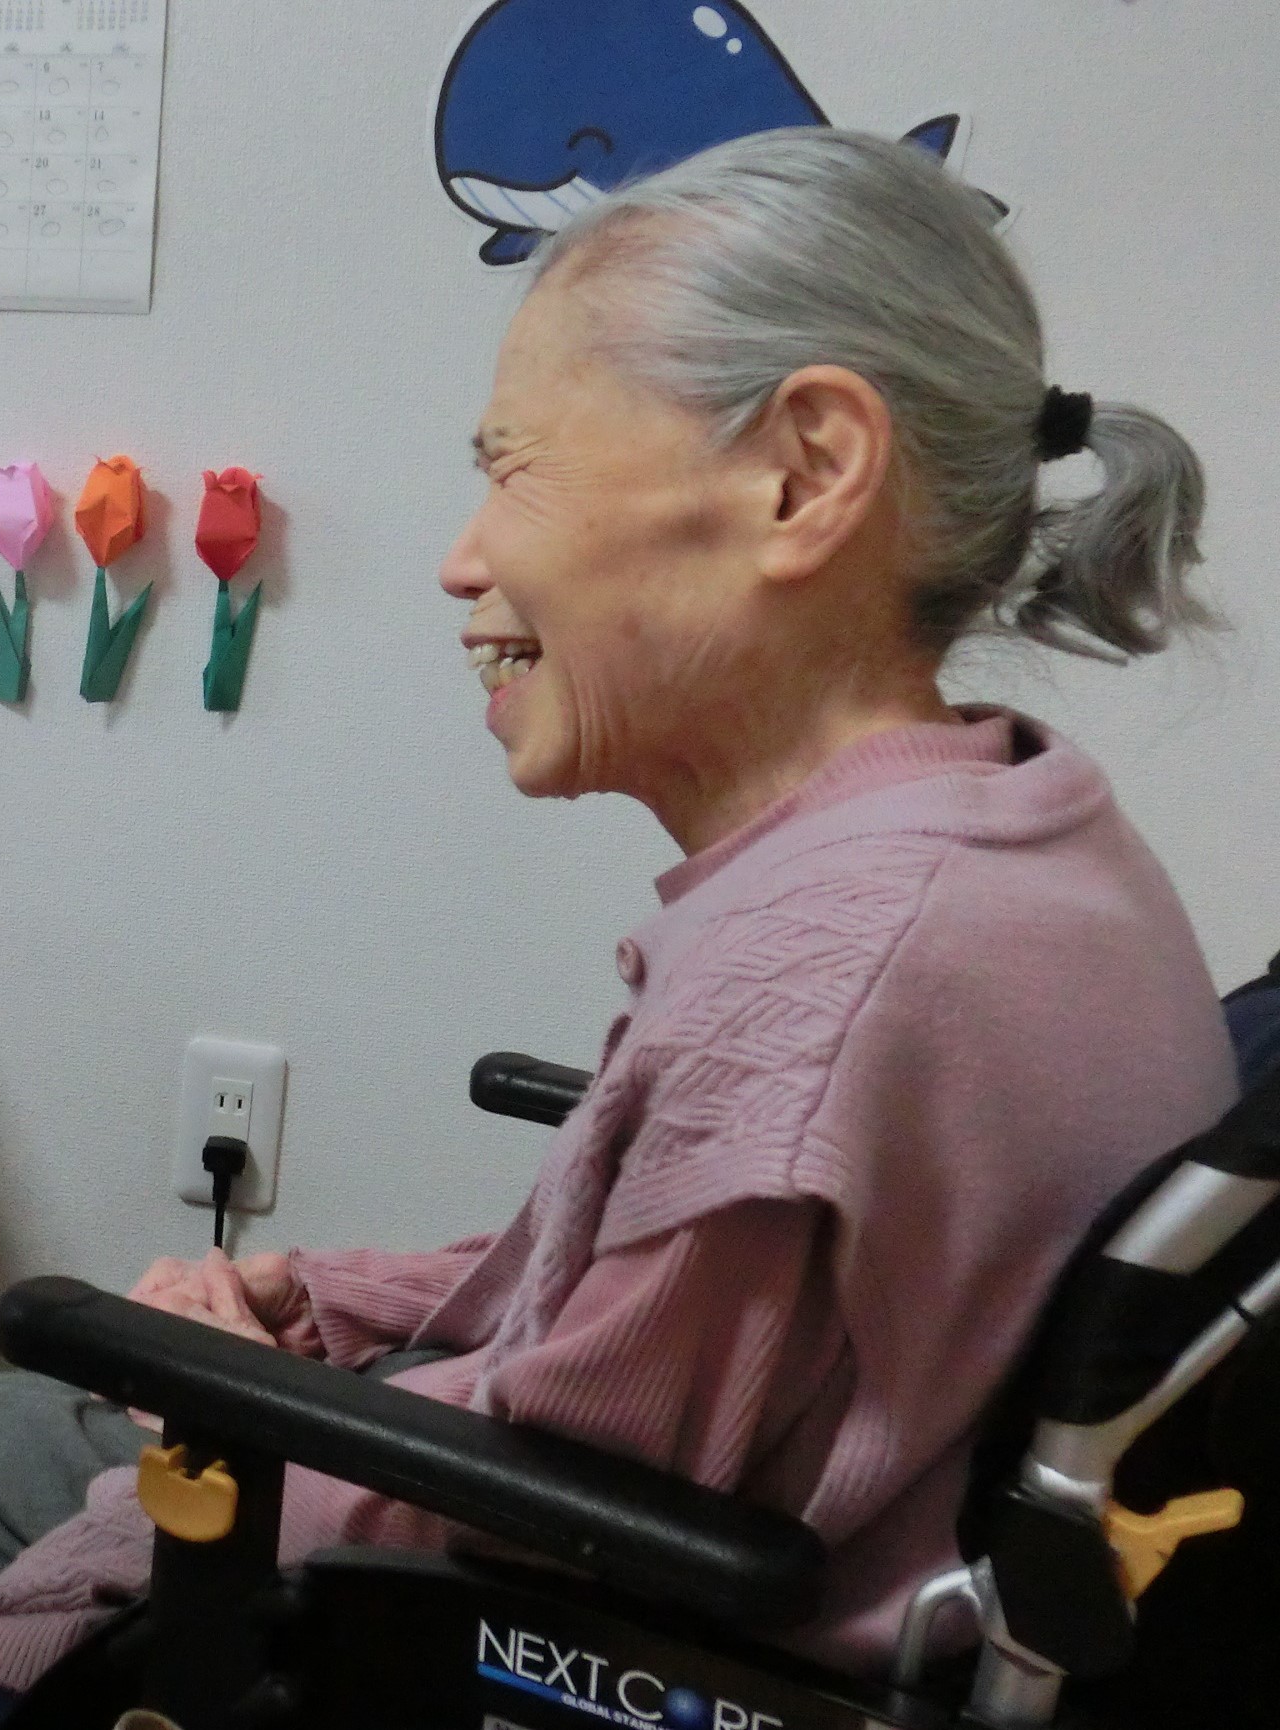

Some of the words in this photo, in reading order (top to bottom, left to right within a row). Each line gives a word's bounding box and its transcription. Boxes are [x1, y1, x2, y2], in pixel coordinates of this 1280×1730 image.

[39, 110, 51, 120] 13
[35, 158, 49, 168] 20
[90, 158, 102, 169] 21
[33, 205, 46, 216] 27
[87, 206, 101, 216] 28
[478, 1616, 610, 1702] NEXT
